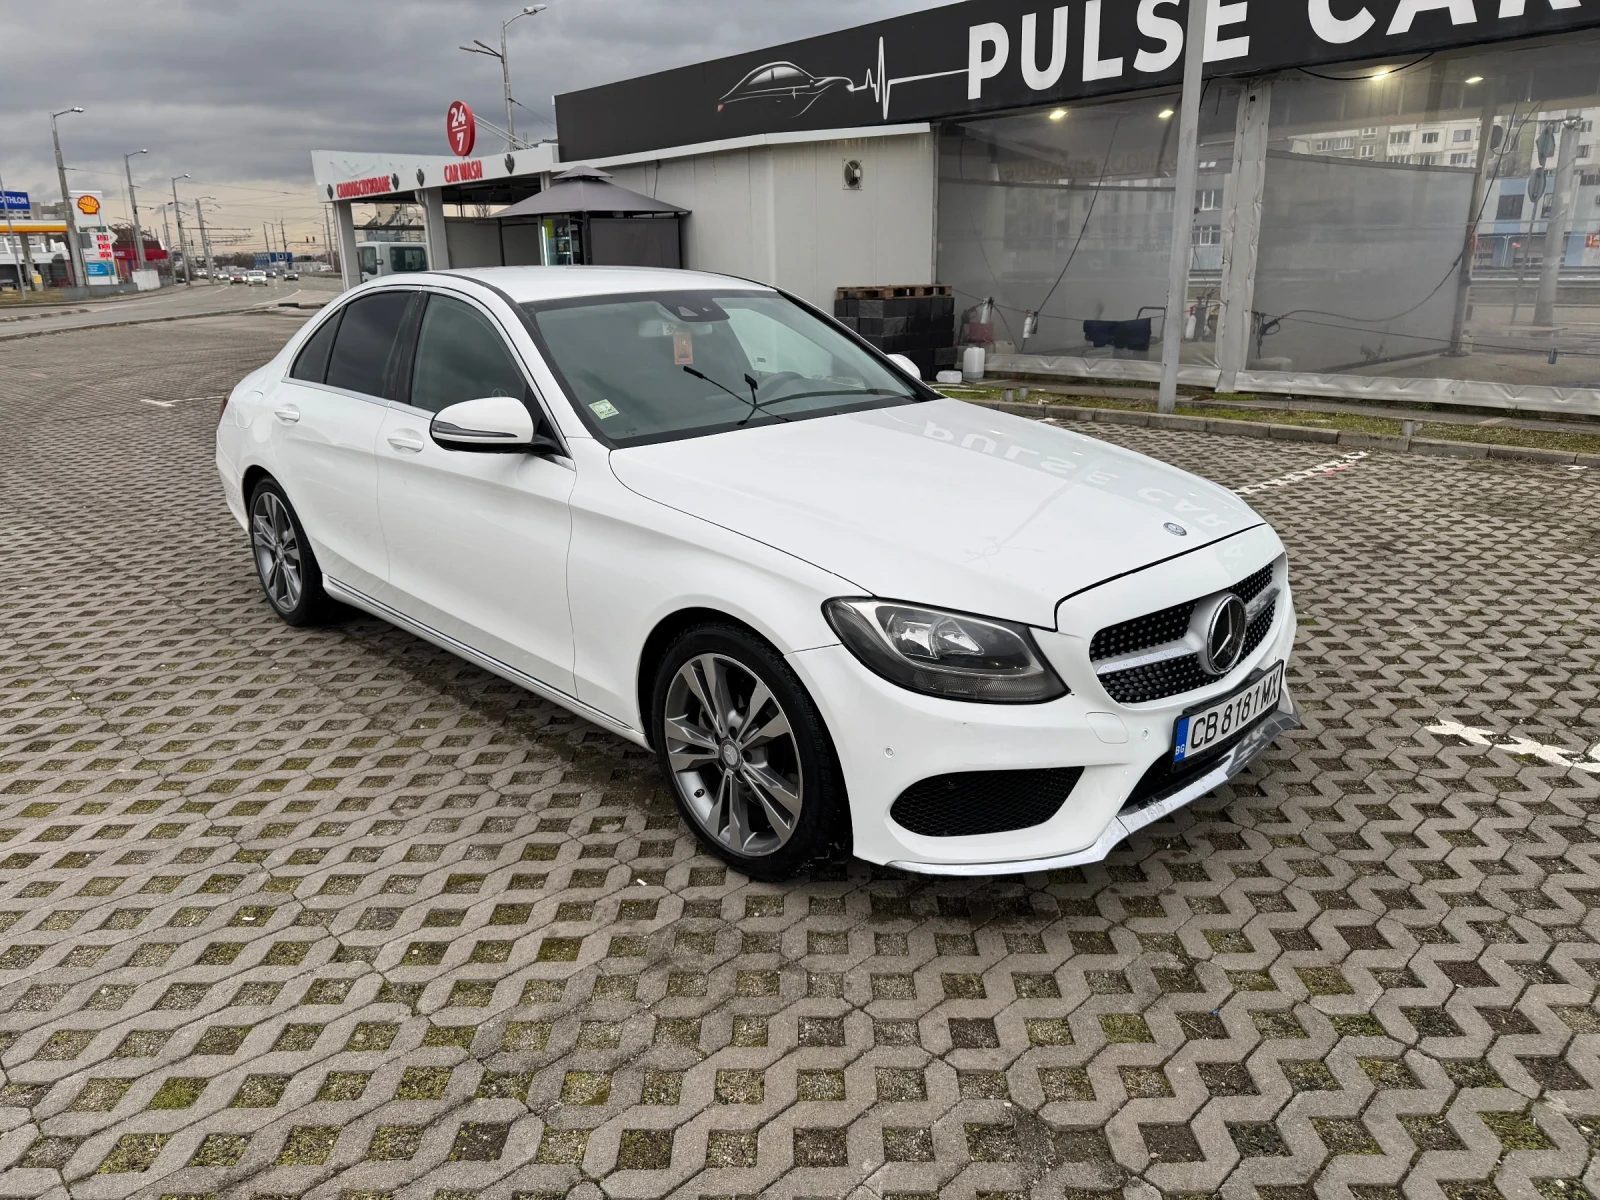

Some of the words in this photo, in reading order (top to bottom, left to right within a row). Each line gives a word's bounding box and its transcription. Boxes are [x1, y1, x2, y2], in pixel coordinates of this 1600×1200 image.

[968, 0, 1250, 100] PULSE
[450, 105, 466, 128] 24
[456, 131, 465, 152] 7
[444, 164, 459, 183] CAR
[459, 160, 483, 181] WASH
[1175, 743, 1186, 756] BG
